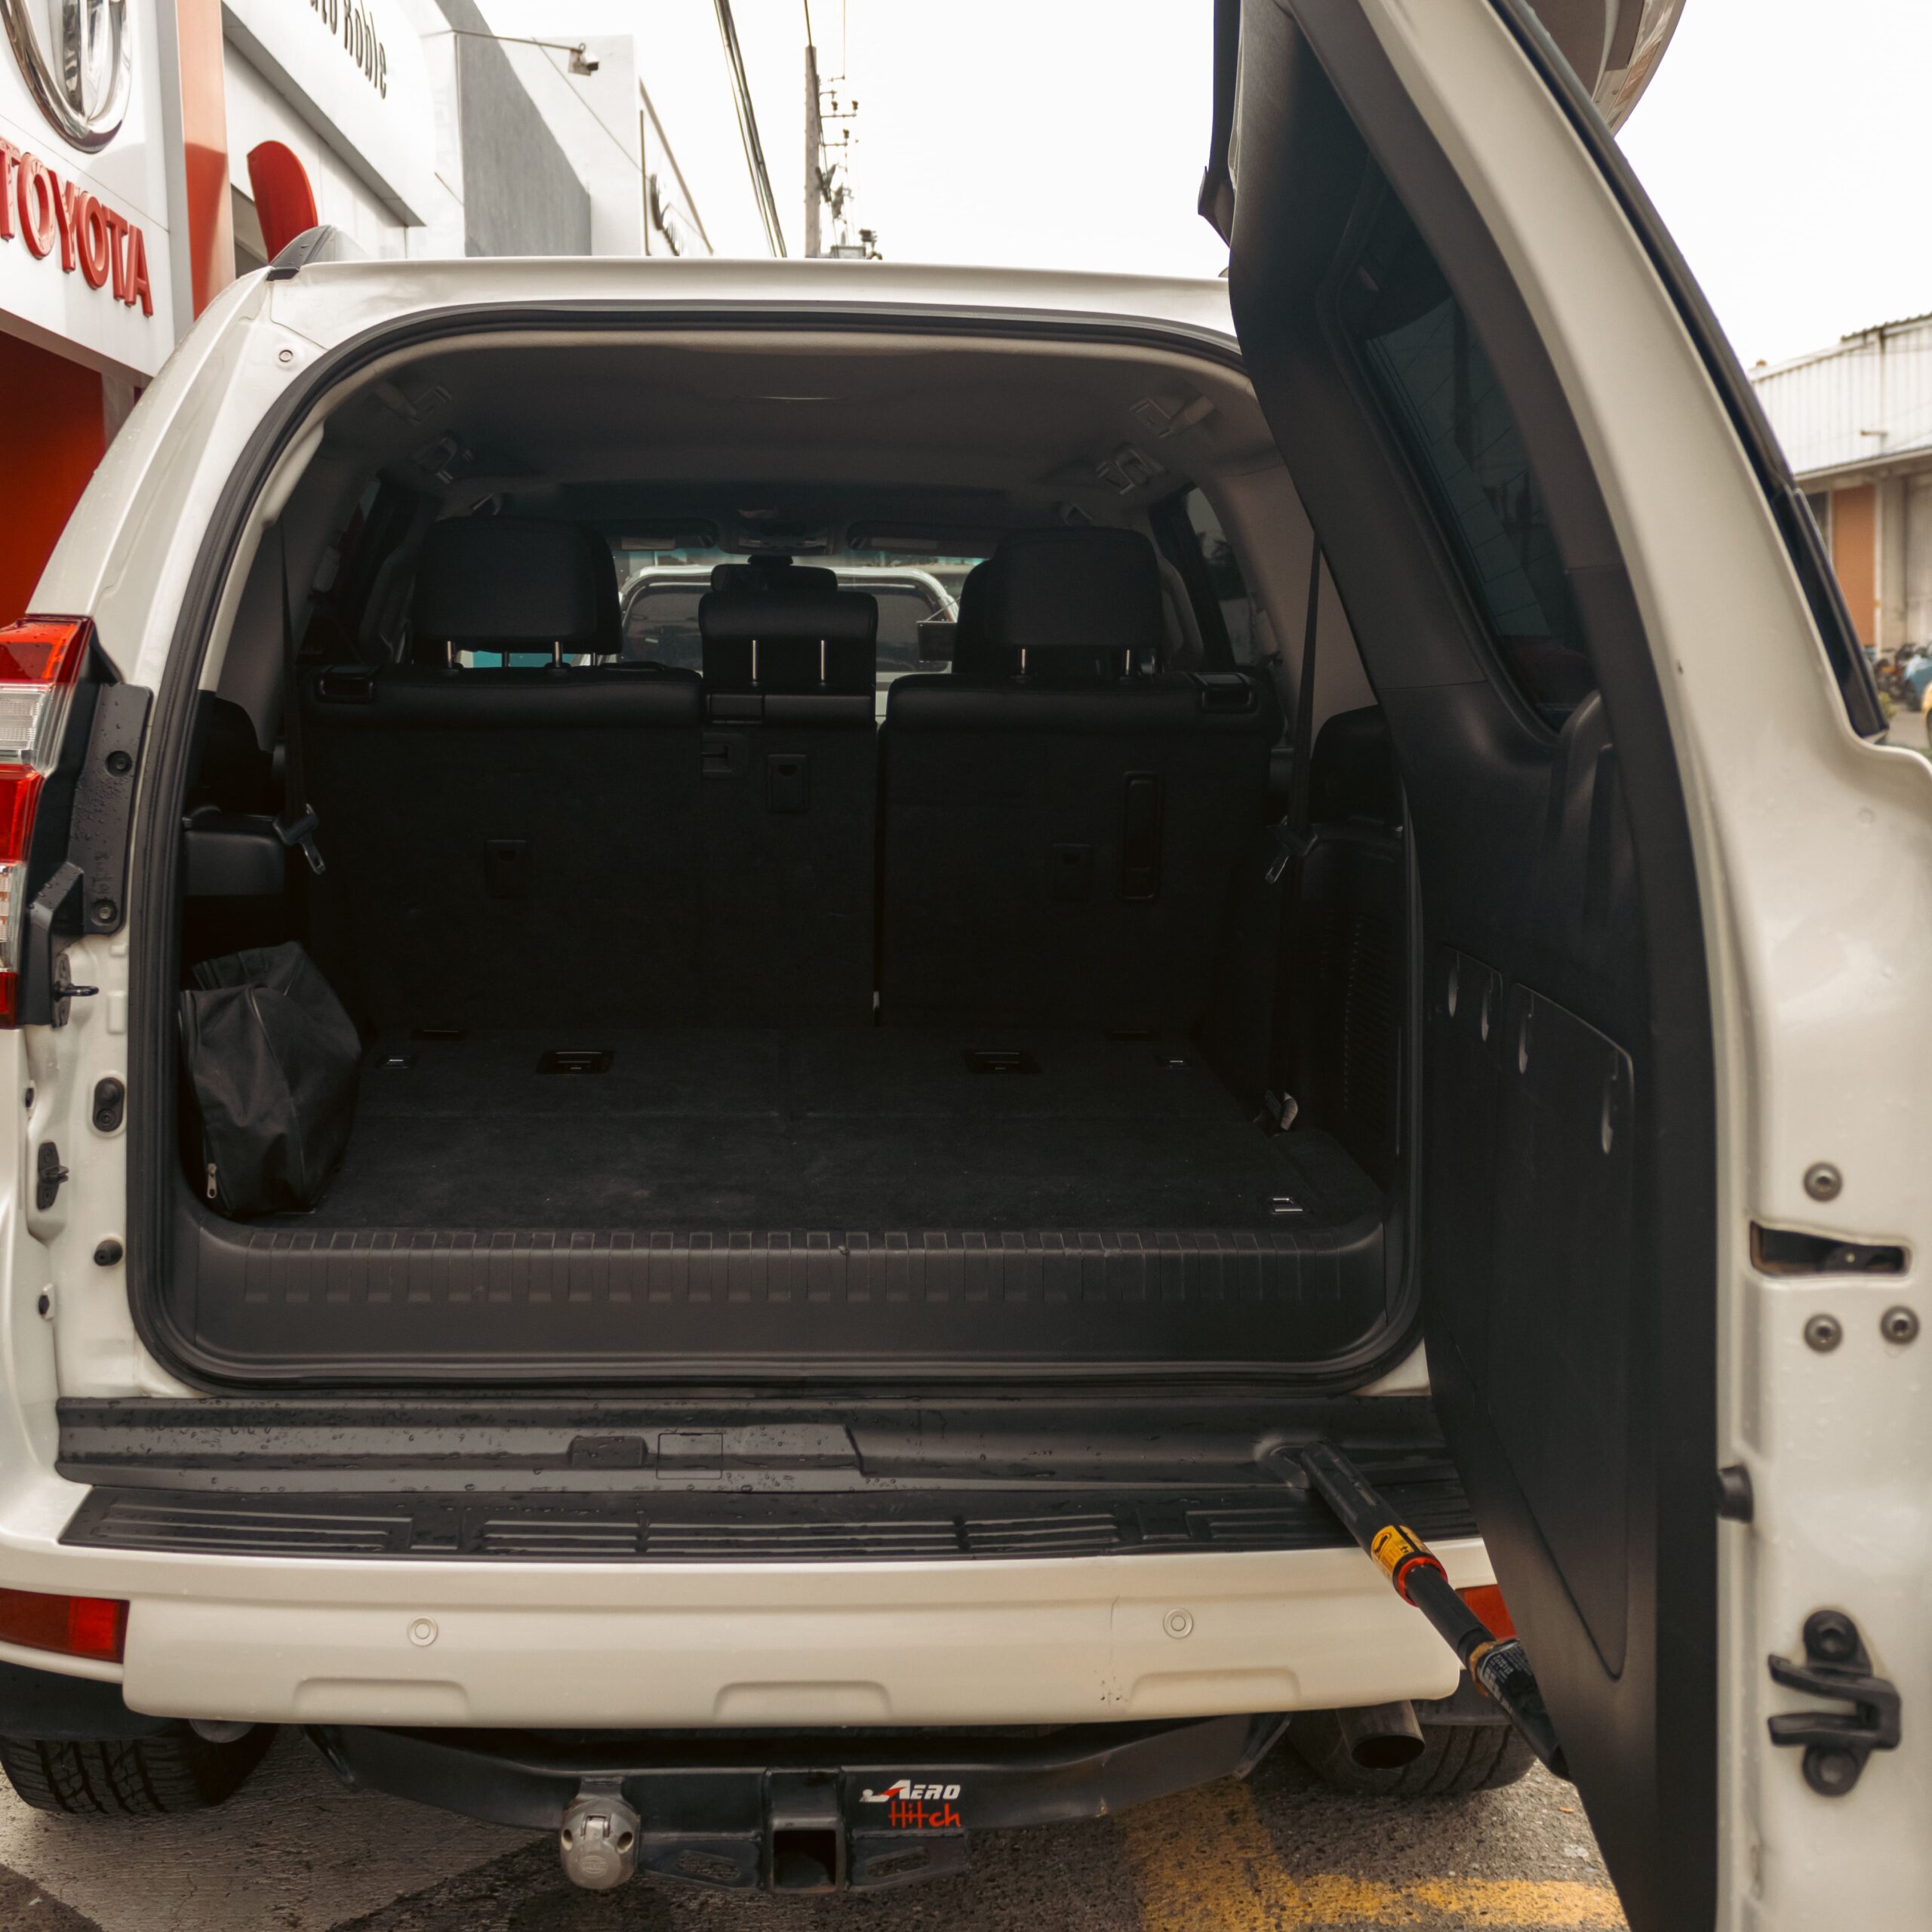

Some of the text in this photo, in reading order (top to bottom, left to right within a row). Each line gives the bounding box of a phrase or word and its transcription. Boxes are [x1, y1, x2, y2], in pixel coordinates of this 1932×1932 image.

[0, 136, 153, 318] TOYOTA
[859, 1780, 961, 1802] AERO
[888, 1799, 961, 1829] Hitch
